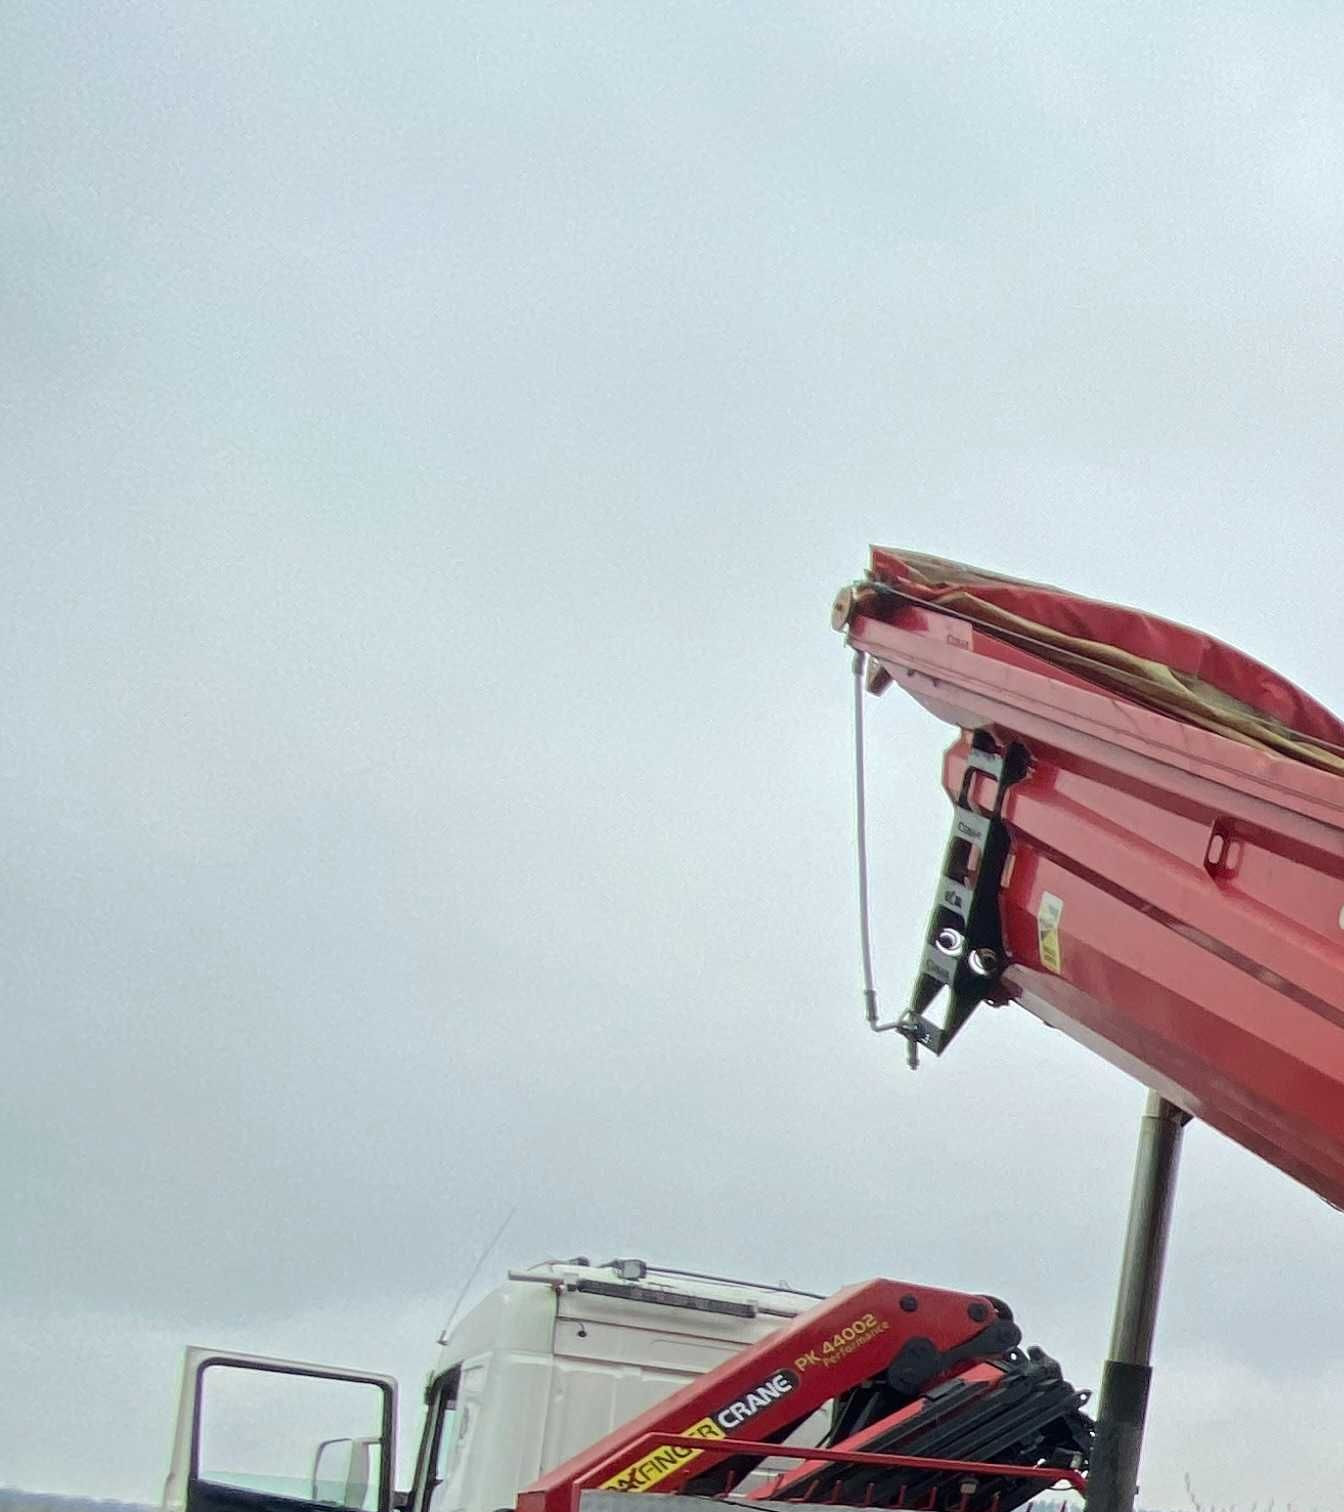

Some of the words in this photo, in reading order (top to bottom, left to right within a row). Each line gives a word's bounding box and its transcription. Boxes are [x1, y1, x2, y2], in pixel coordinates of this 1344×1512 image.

[794, 1349, 821, 1372] PK
[823, 1313, 877, 1354] 44002
[717, 1374, 793, 1428] CRANE
